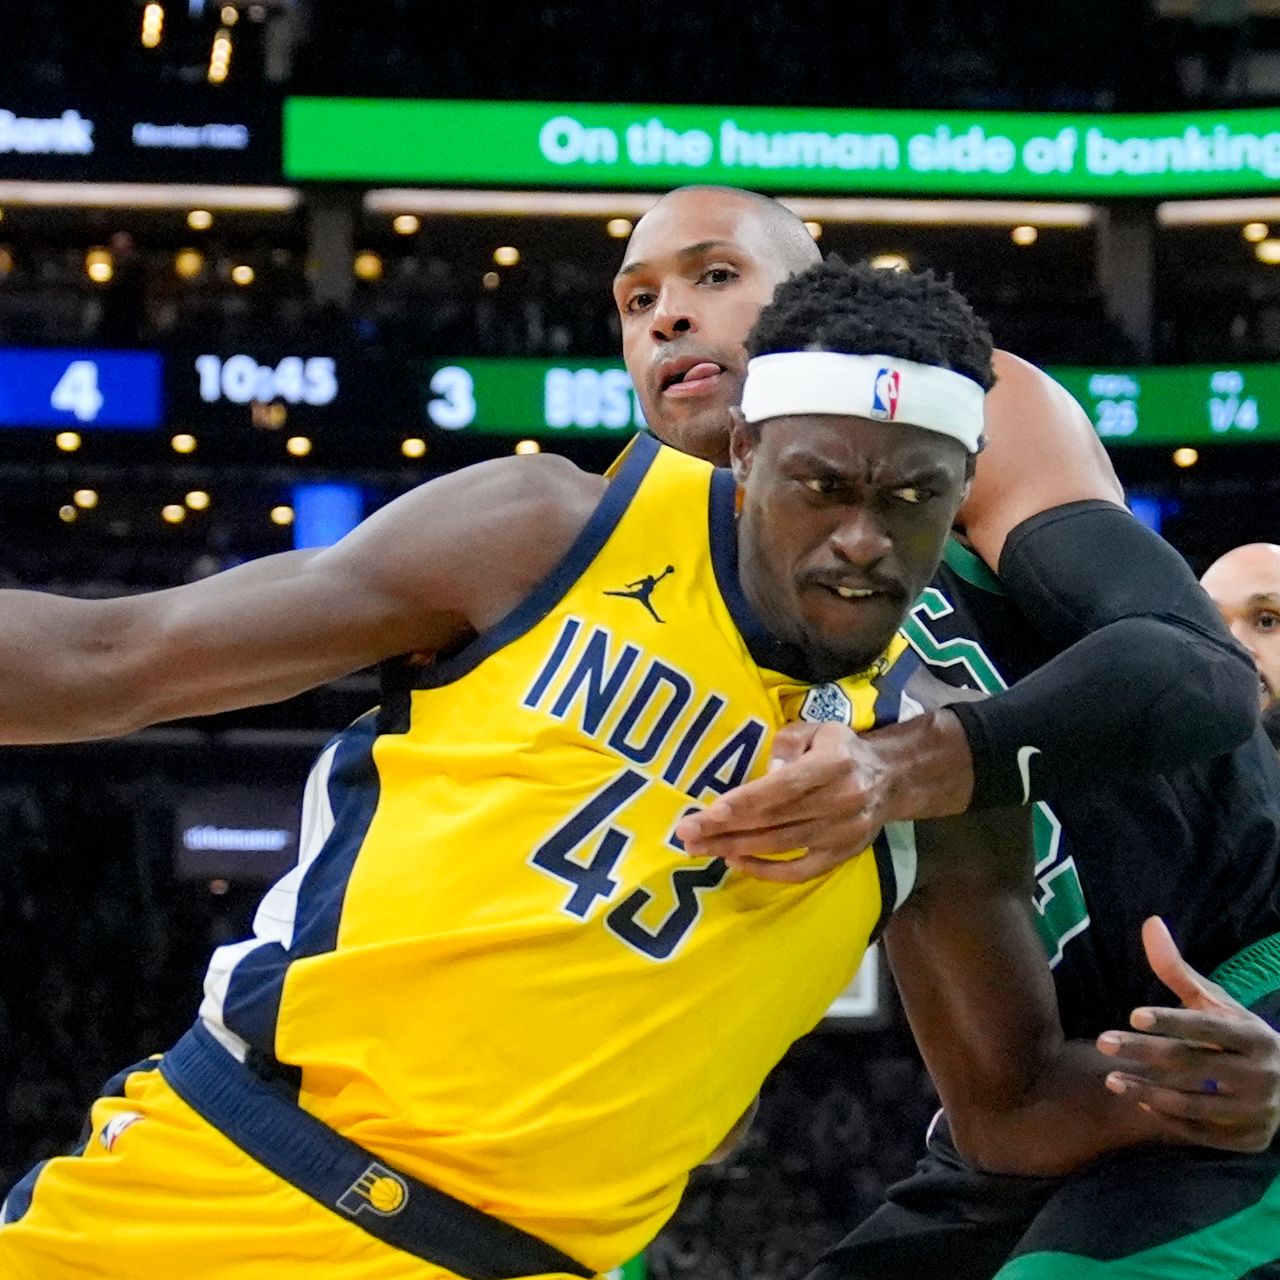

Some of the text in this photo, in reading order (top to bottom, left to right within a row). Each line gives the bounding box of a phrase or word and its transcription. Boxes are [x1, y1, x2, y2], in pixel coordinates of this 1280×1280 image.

[540, 116, 618, 164] On
[626, 119, 713, 166] the
[720, 121, 899, 169] human
[908, 127, 1015, 173] side
[1023, 128, 1077, 173] of
[51, 361, 103, 421] 4
[195, 355, 337, 405] 10:45
[427, 366, 648, 430] 3 BOS
[523, 614, 768, 798] INDIA
[527, 767, 730, 962] 43
